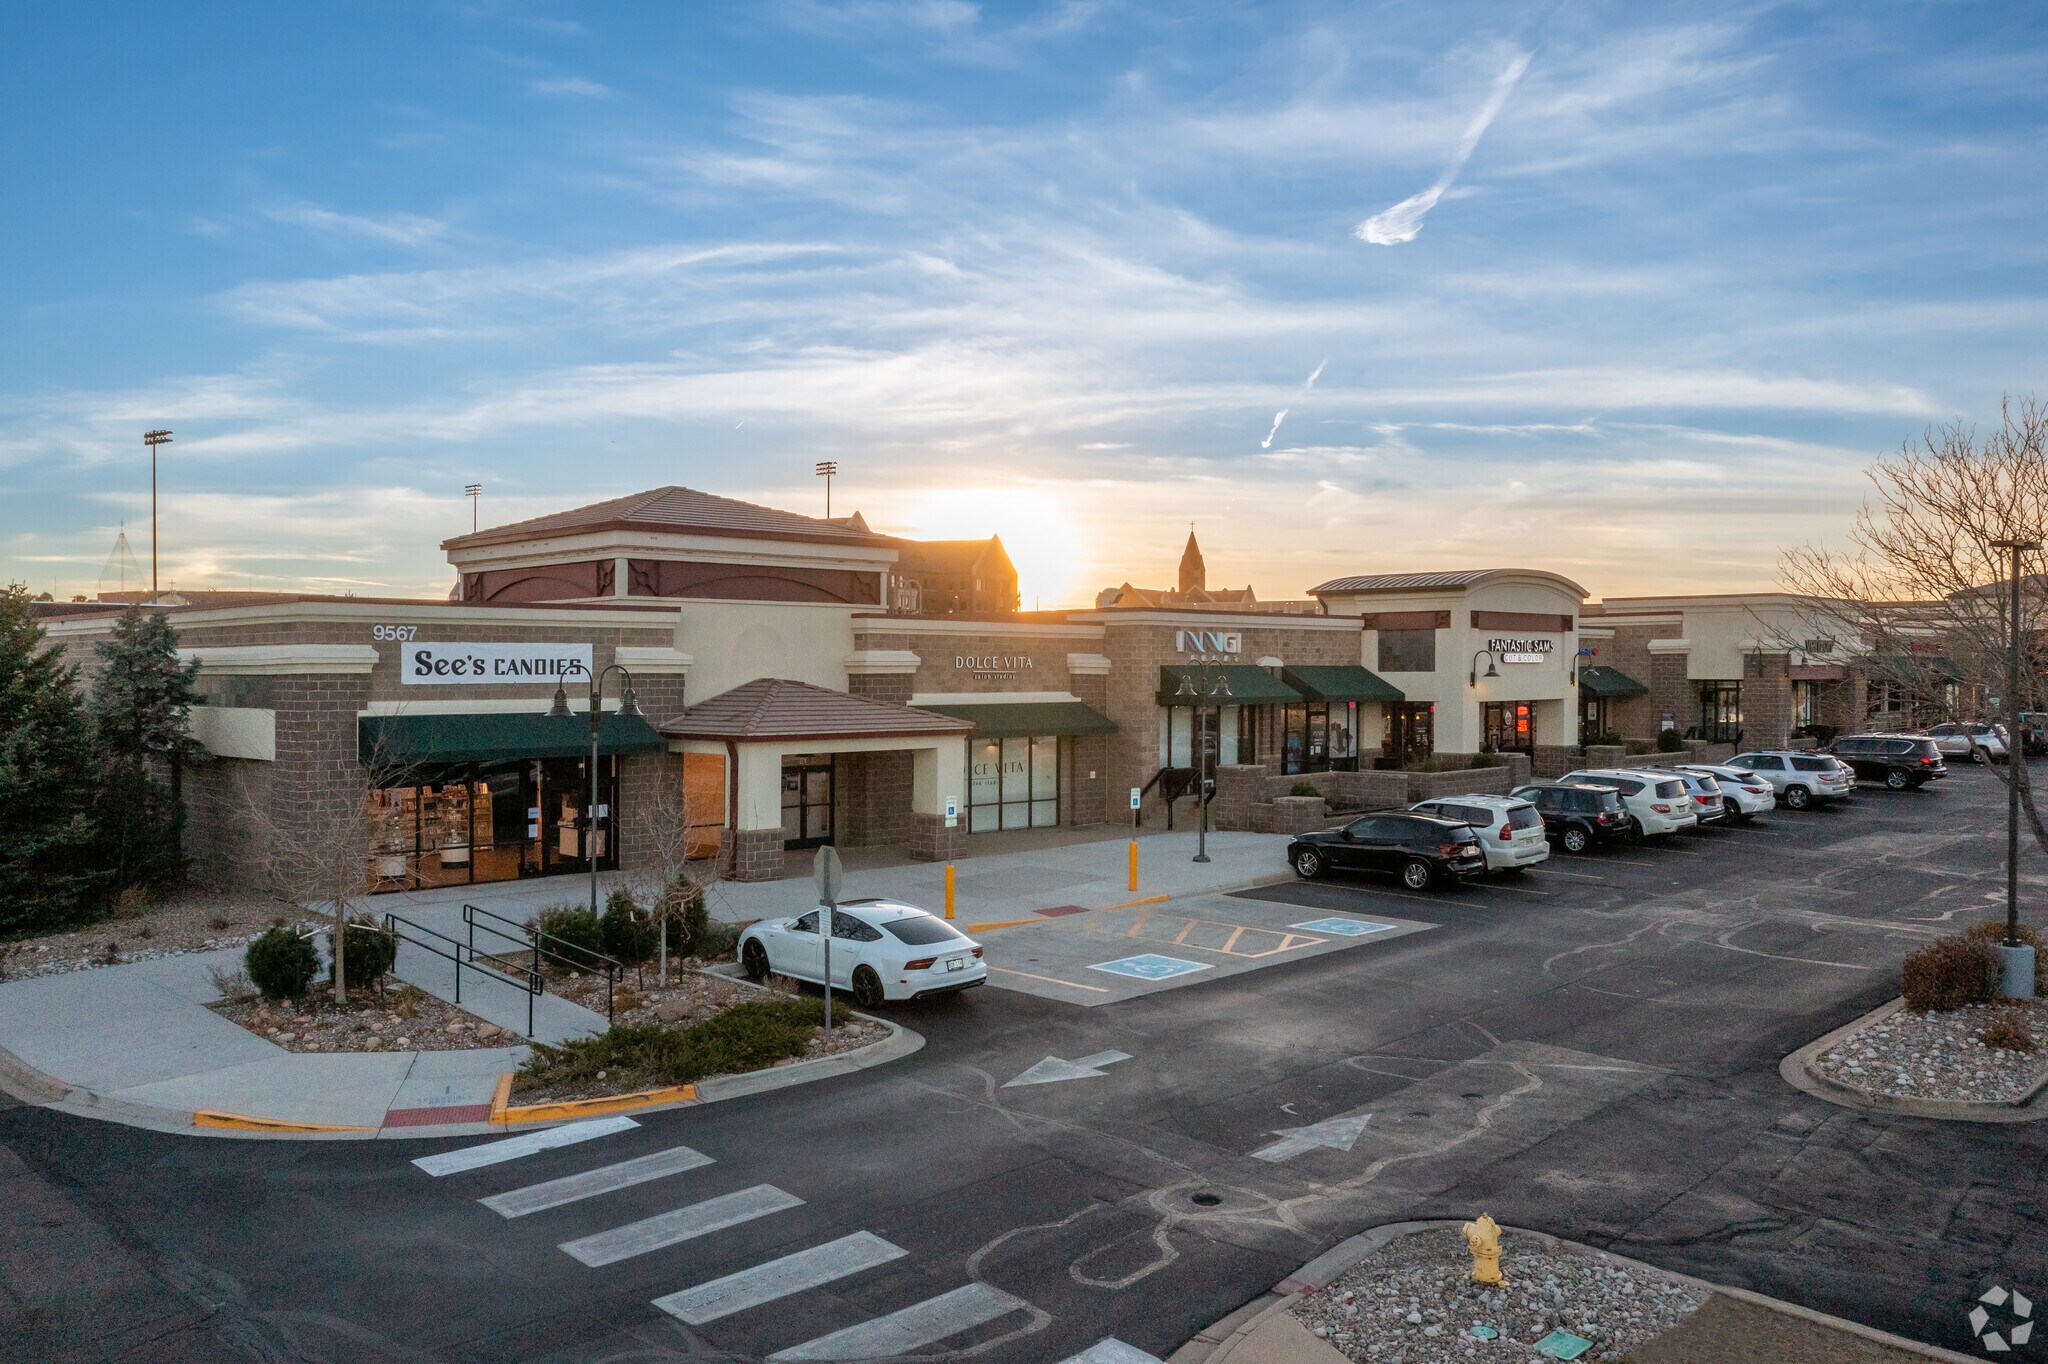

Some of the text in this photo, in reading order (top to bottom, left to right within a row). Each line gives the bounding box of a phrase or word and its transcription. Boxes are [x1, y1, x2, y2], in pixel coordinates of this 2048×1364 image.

[373, 625, 417, 641] 9567
[1490, 639, 1554, 652] FANTASTIC SAMS
[415, 650, 581, 676] See's CANDIES
[955, 656, 1033, 669] DOLCE VITA
[1504, 654, 1517, 662] CUT
[1523, 654, 1544, 662] COLOR
